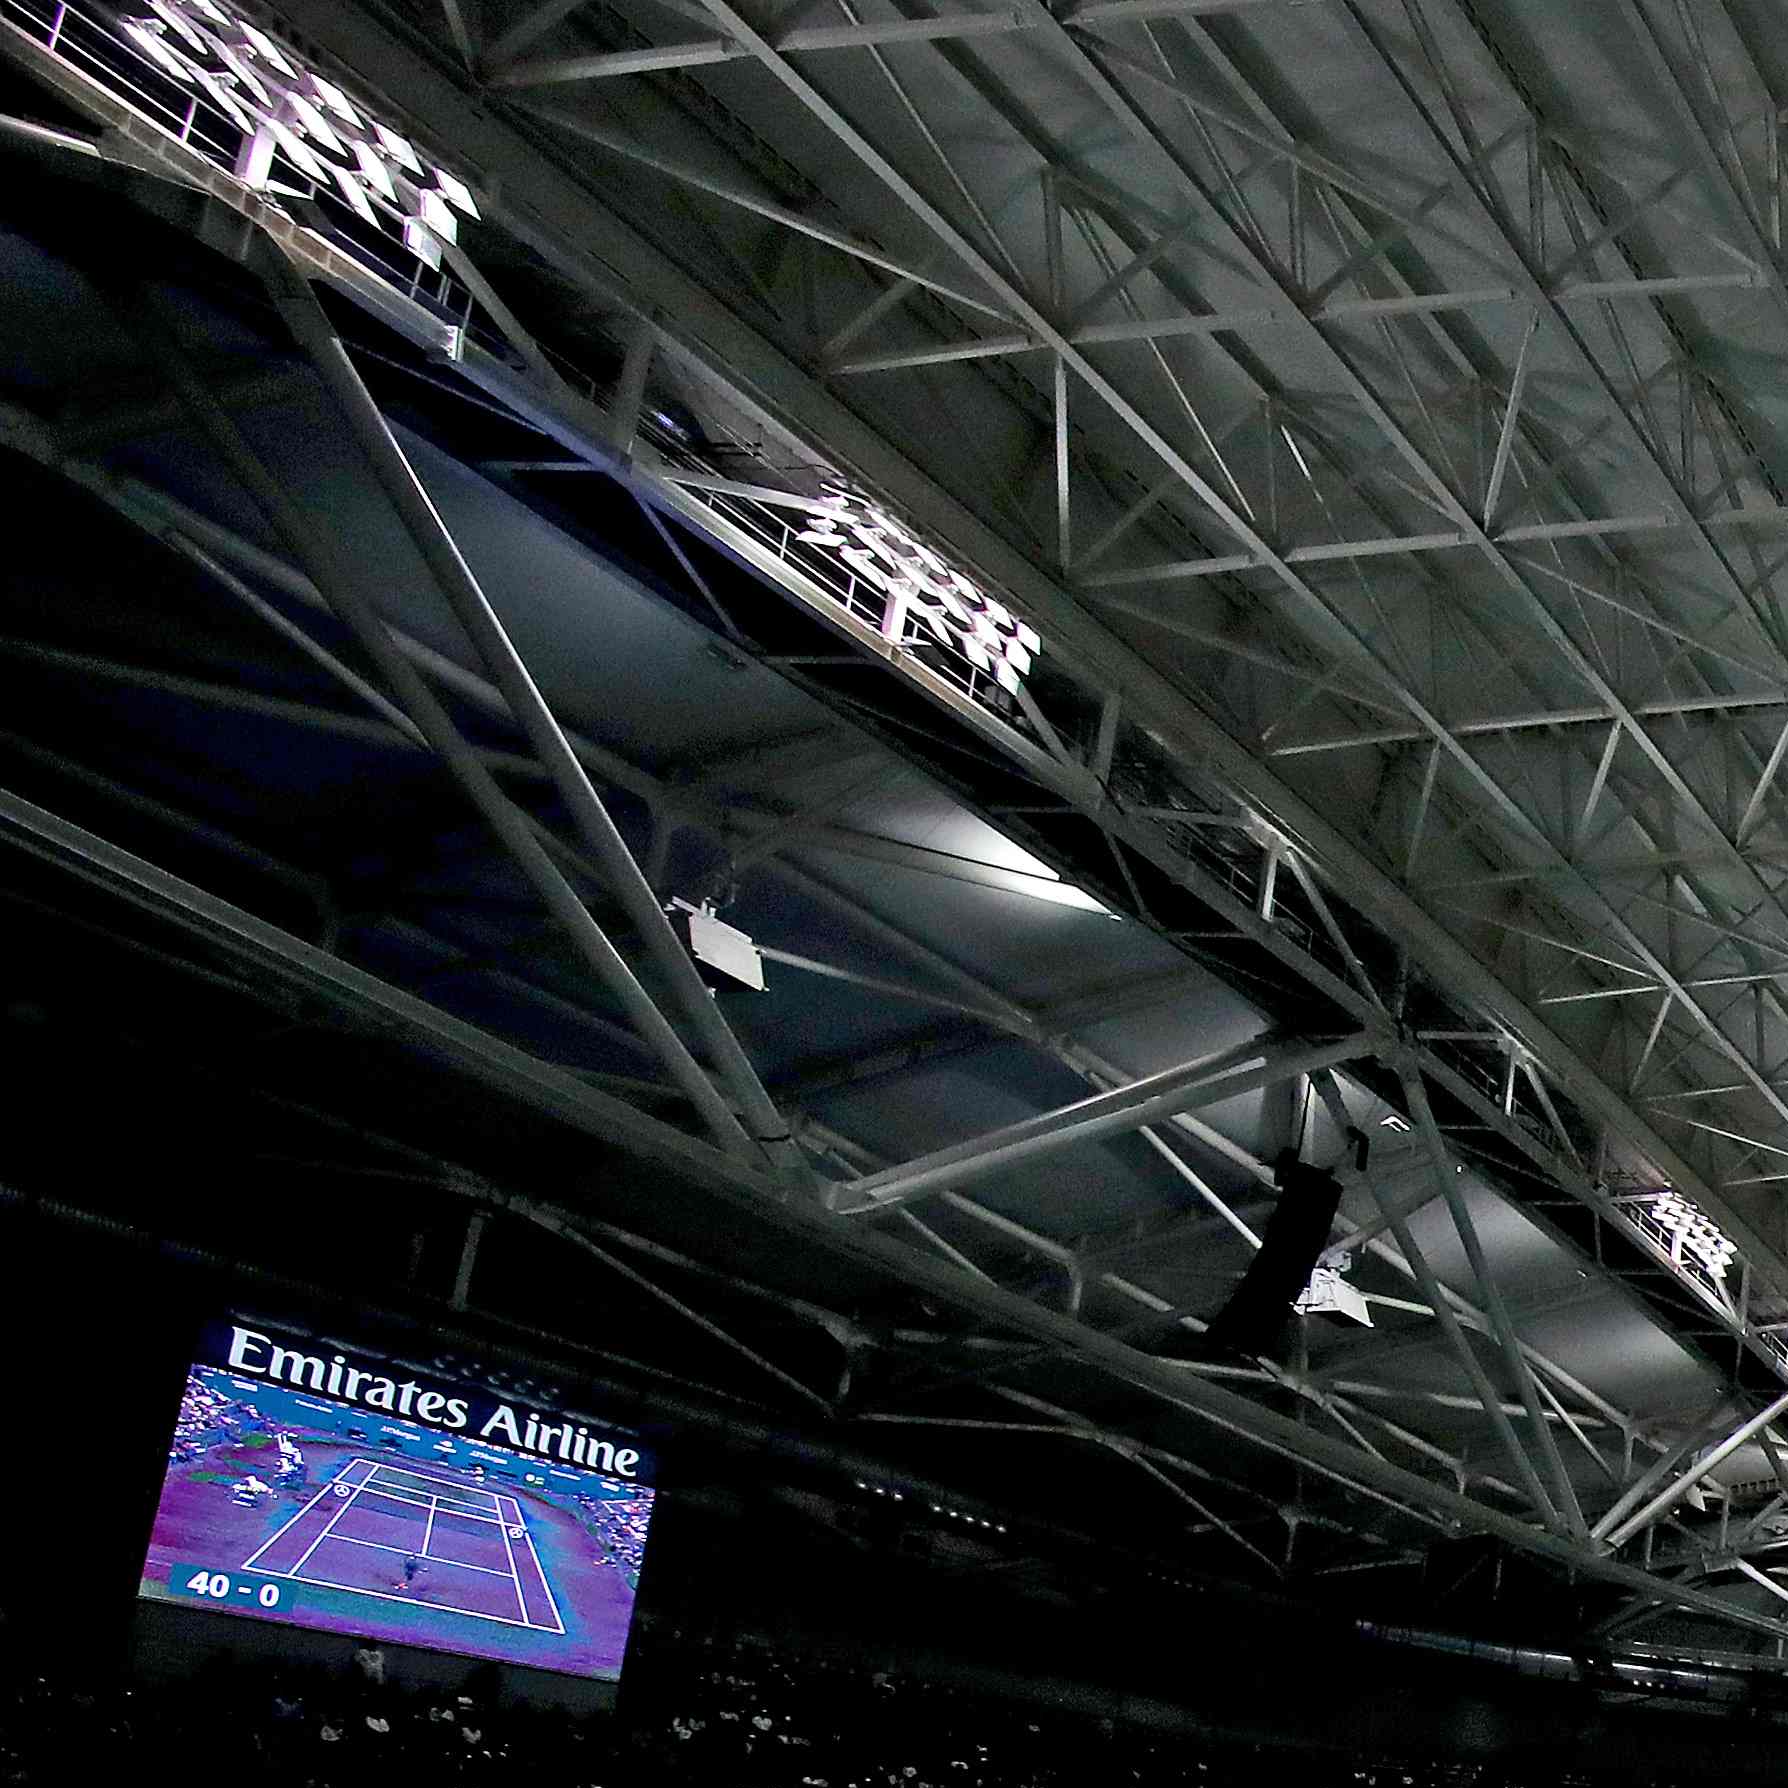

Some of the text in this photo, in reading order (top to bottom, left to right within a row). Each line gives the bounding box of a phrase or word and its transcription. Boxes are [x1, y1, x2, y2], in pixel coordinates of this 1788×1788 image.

[227, 1325, 641, 1477] Emirates Airline
[187, 1570, 229, 1599] 40
[259, 1582, 280, 1608] 0
